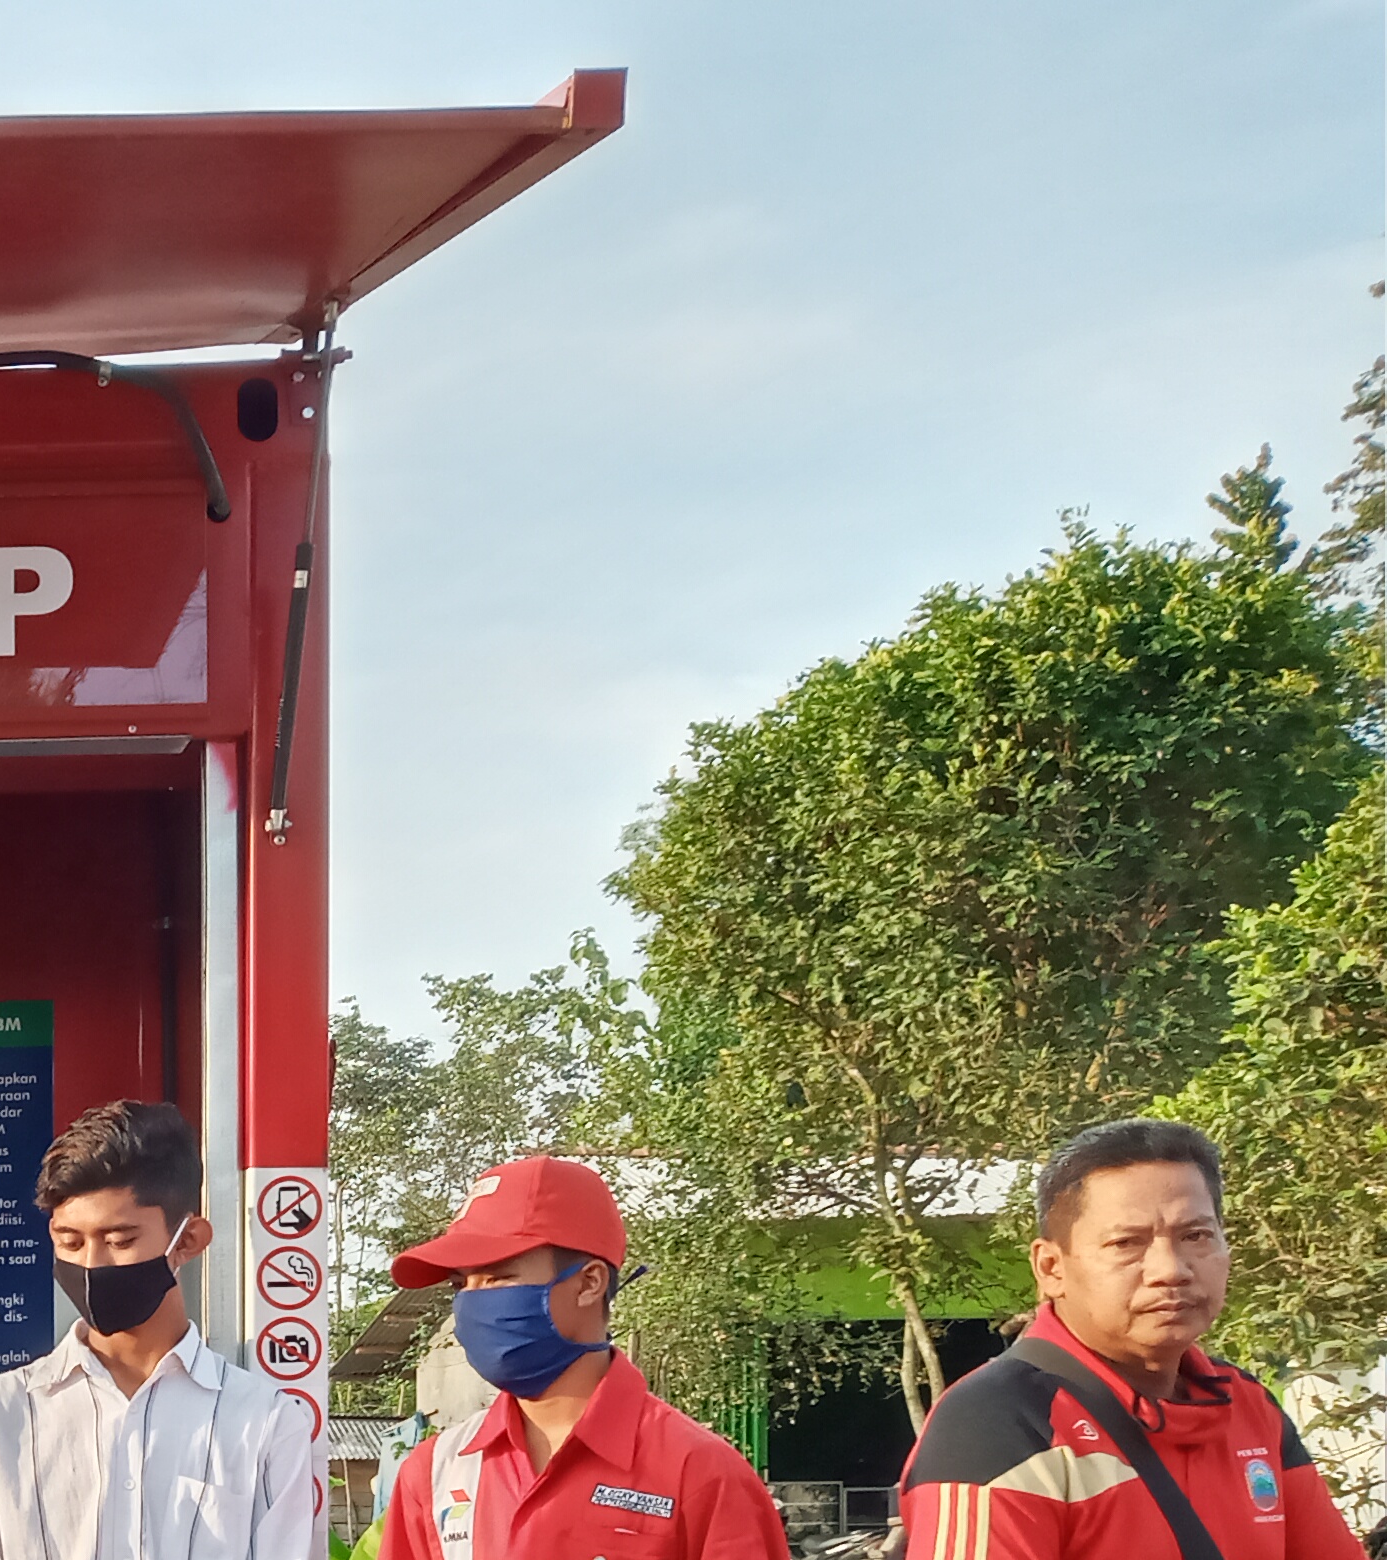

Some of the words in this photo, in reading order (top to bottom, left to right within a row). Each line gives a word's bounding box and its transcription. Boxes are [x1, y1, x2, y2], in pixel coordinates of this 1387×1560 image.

[13, 1239, 39, 1247] me-
[8, 1254, 36, 1264] saat
[4, 1310, 28, 1322] dis-
